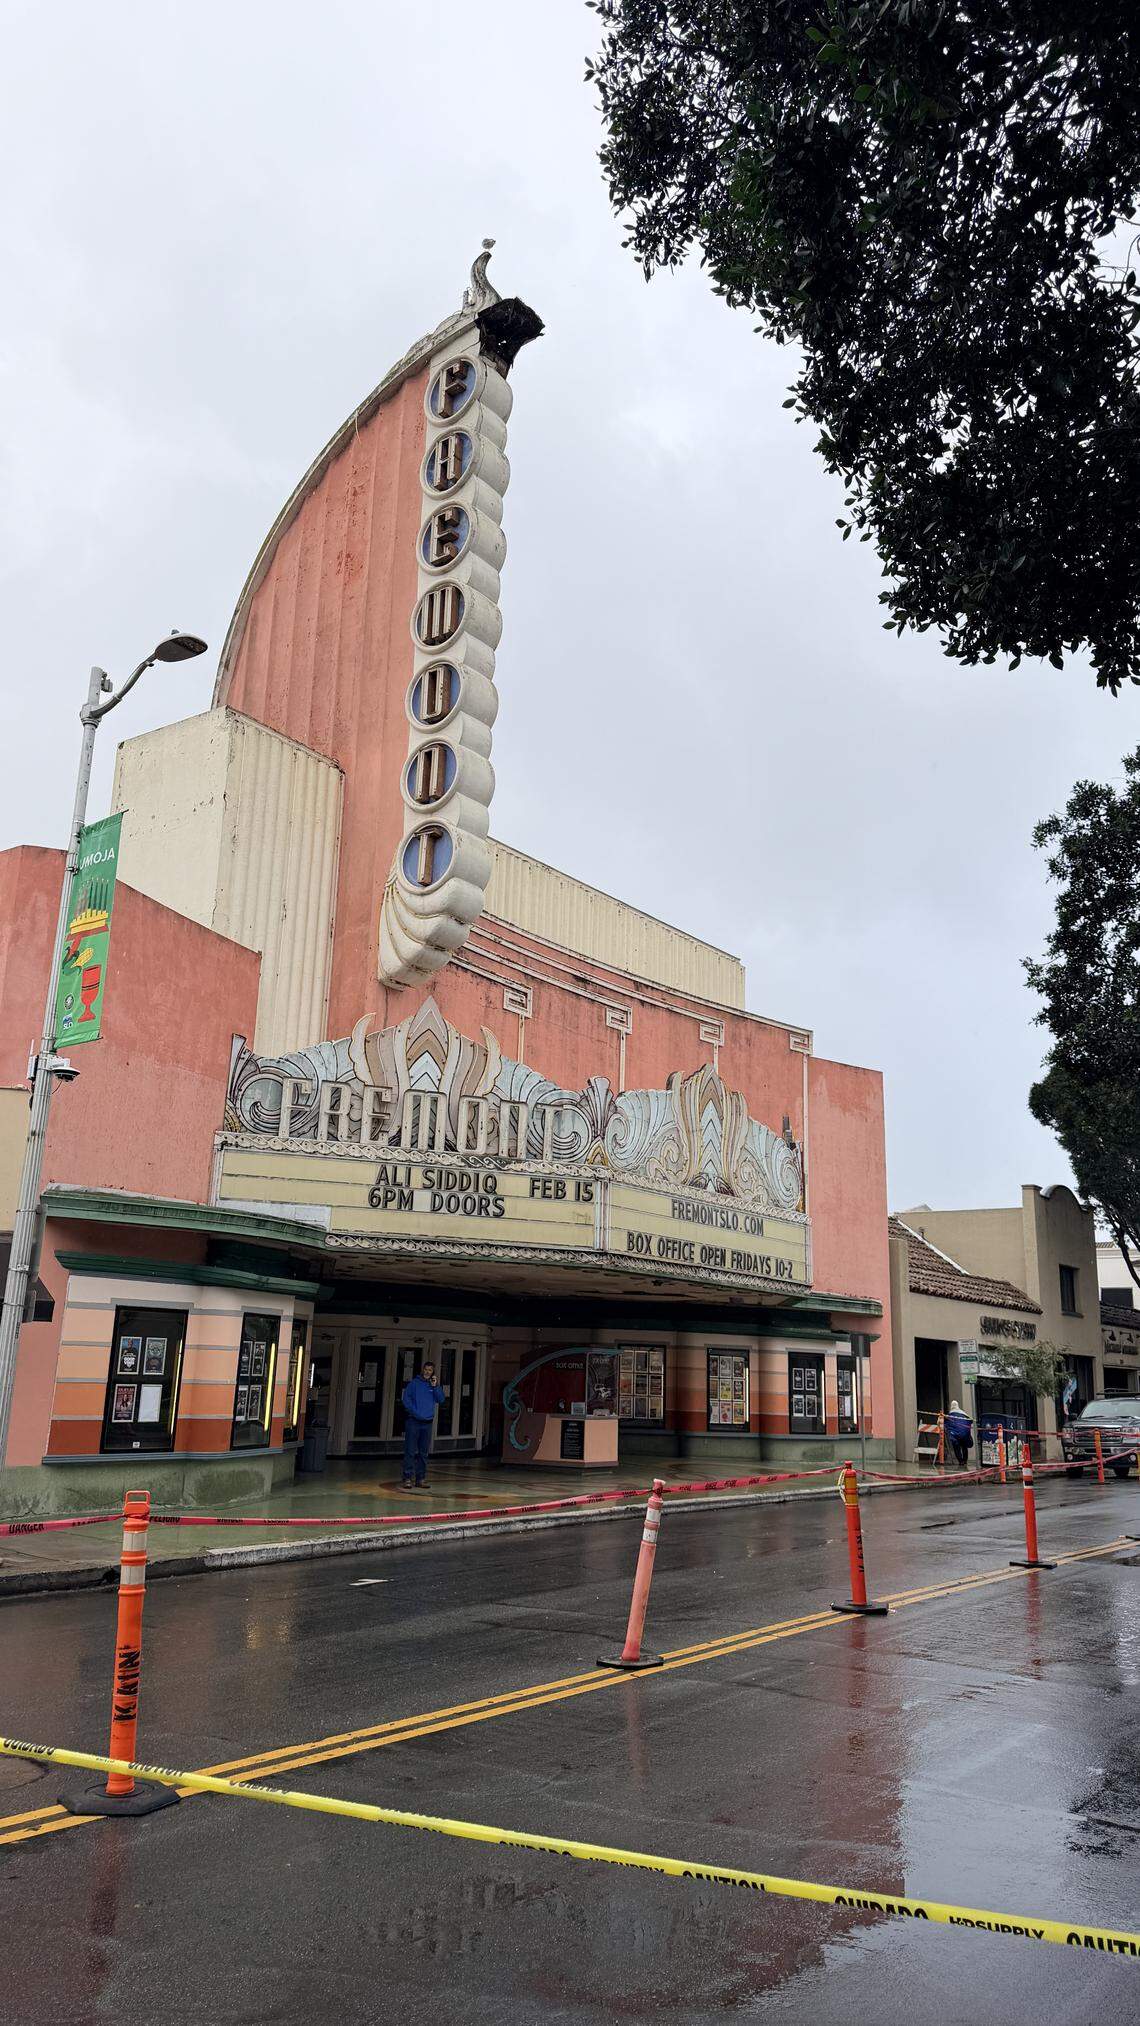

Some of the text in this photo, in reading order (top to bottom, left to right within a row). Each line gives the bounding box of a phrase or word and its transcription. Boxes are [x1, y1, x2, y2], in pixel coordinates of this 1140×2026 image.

[413, 360, 468, 886] FREMONT
[277, 1076, 565, 1162] FREMONT
[368, 1186, 506, 1217] 6PM DOORS
[375, 1164, 595, 1202] ALI SIDDIQ FEB 15
[626, 1231, 793, 1279] BOX OFFICE OPEN FRIDAYS 10-2
